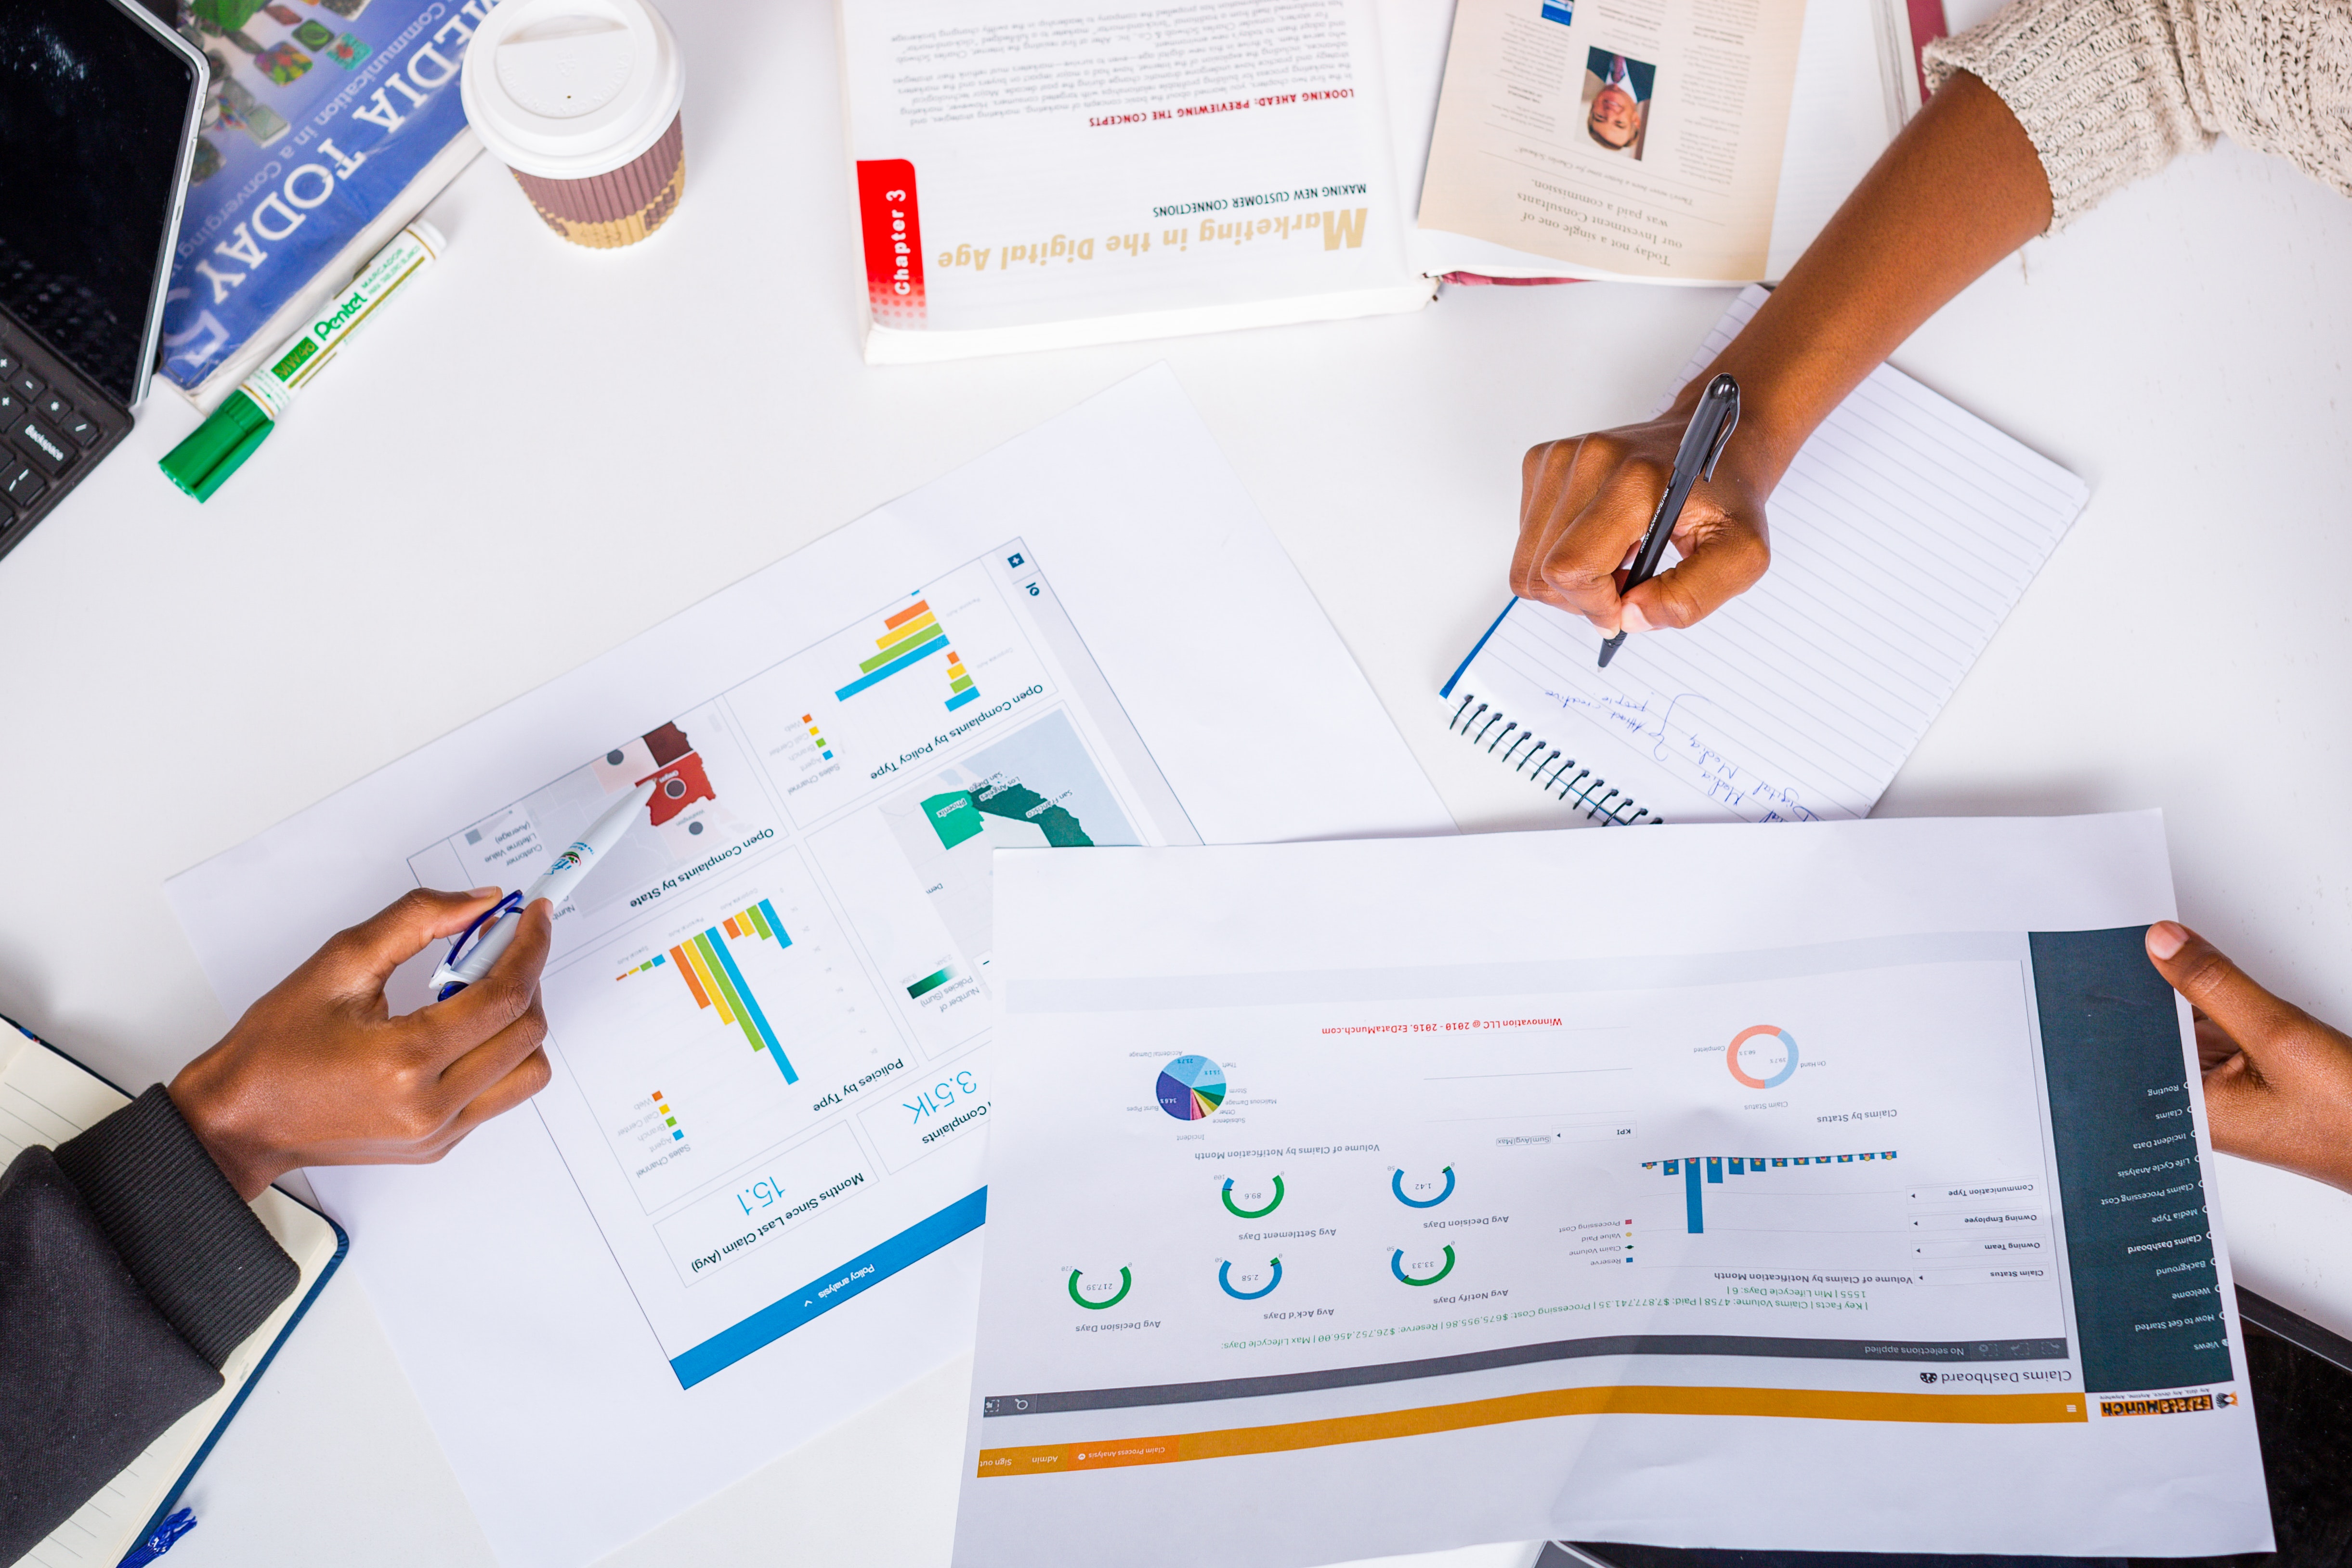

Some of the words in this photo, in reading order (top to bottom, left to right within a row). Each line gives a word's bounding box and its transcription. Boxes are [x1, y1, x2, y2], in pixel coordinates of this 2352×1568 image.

[312, 0, 448, 130] Communication
[1255, 93, 1297, 107] AHEAD:
[1301, 88, 1354, 102] LOOKING
[1151, 109, 1172, 120] THE
[1176, 99, 1250, 118] PREVIEWING
[1088, 112, 1147, 127] CONCEPTS
[290, 124, 318, 151] in
[277, 144, 296, 163] a
[885, 189, 906, 201] 3
[1293, 187, 1318, 201] NEW
[1321, 183, 1366, 197] MAKING
[1530, 178, 1604, 208] commission.
[1231, 191, 1290, 208] CUSTOMER
[174, 156, 283, 261] Converging
[1152, 198, 1228, 218] CONNECTIONS
[1516, 192, 1588, 223] Consultants
[1606, 202, 1614, 211] a
[1615, 205, 1643, 220] paid
[186, 128, 368, 305] TODAY
[1519, 211, 1535, 222] of
[1537, 216, 1560, 229] one
[1646, 215, 1669, 228] was
[1198, 207, 1368, 251] Marketing
[1562, 223, 1596, 242] single
[1591, 215, 1658, 245] Investment
[1105, 231, 1151, 257] the
[1162, 227, 1188, 252] in
[1600, 235, 1607, 244] a
[1610, 238, 1630, 251] not
[1661, 236, 1683, 249] our
[890, 209, 911, 294] Chapter
[937, 242, 991, 272] Age
[1000, 233, 1095, 271] Digital
[1633, 244, 1671, 267] Today
[360, 246, 405, 290] MARCADOR
[311, 286, 368, 342] Pentel
[1011, 684, 1043, 704] Open
[948, 701, 1012, 737] Complaints
[934, 734, 949, 746] by
[899, 742, 934, 765] Policy
[870, 762, 899, 780] Type
[988, 770, 1003, 783] San
[967, 776, 990, 794] Diego
[1006, 775, 1020, 787] Los
[978, 780, 1007, 802] Angeles
[1058, 788, 1073, 801] San
[1701, 772, 1746, 806] Media
[936, 797, 967, 819] Phoenix
[742, 828, 774, 848] Open
[677, 845, 742, 882] Complaints
[662, 878, 678, 891] by
[629, 887, 661, 907] State
[1445, 1021, 1470, 1031] 2010
[1482, 1020, 1501, 1029] LLC
[1502, 1017, 1563, 1028] Winnovation
[1321, 1024, 1408, 1035] EzDataMunch.com
[858, 1058, 904, 1086] Policies
[843, 1083, 859, 1096] by
[2146, 1084, 2180, 1097] Routing
[812, 1093, 843, 1111] Type
[902, 1070, 977, 1125] 3.51K
[1816, 1113, 1849, 1123] Status
[1850, 1111, 1863, 1121] by
[1863, 1108, 1897, 1119] Claims
[2155, 1108, 2183, 1120] Claims
[921, 1105, 987, 1144] Complaints
[2132, 1140, 2153, 1150] Data
[2152, 1132, 2187, 1146] Incident
[2151, 1160, 2174, 1172] Cycle
[2174, 1157, 2191, 1167] Life
[2117, 1165, 2152, 1178] Analysis
[818, 1172, 864, 1201] Months
[1947, 1188, 1968, 1197] Type
[1968, 1183, 2034, 1196] Communication
[2165, 1182, 2195, 1194] Claims
[736, 1176, 786, 1216] 15.1
[2100, 1196, 2120, 1205] Cost
[2119, 1189, 2166, 1202] Processing
[784, 1198, 819, 1220] Since
[2172, 1207, 2198, 1219] Media
[1423, 1220, 1446, 1229] Days
[1447, 1217, 1490, 1227] Decision
[1491, 1215, 1509, 1223] Avg
[1963, 1215, 2003, 1224] Employee
[2004, 1214, 2038, 1222] Owning
[2151, 1213, 2173, 1223] Type
[756, 1215, 785, 1237] Last
[721, 1232, 757, 1254] Claim
[2173, 1233, 2202, 1245] Claims
[2127, 1240, 2173, 1254] Dashboard
[691, 1249, 722, 1273] (Avg)
[1411, 1260, 1434, 1269] 33.33
[849, 1263, 875, 1281] Policy
[2155, 1260, 2207, 1277] Background
[1713, 1272, 1747, 1281] Month
[1748, 1273, 1810, 1283] Notification
[1811, 1274, 1824, 1283] by
[1824, 1275, 1860, 1284] Claims
[1861, 1276, 1873, 1284] of
[1874, 1276, 1914, 1284] Volume
[817, 1276, 850, 1299] analysis
[1085, 1282, 1113, 1291] 217.39
[1490, 1289, 1509, 1297] Avg
[1731, 1286, 1739, 1295] 6
[1769, 1287, 1812, 1297] Lifecycle
[2171, 1286, 2211, 1300] Welcome
[1432, 1295, 1456, 1304] Days
[1457, 1292, 1489, 1302] Notify
[1814, 1290, 1833, 1298] Min
[1840, 1290, 1866, 1299] 1555
[1672, 1297, 1697, 1306] Paid:
[1703, 1297, 1731, 1307] 4758
[1733, 1298, 1773, 1308] Volume:
[1774, 1299, 1808, 1309] Claims
[1815, 1301, 1842, 1310] Facts
[1843, 1300, 1863, 1310] Key
[1510, 1309, 1536, 1319] Cost:
[1537, 1302, 1591, 1315] Processing
[1142, 1319, 1162, 1329] Avg
[2167, 1319, 2183, 1328] Get
[2194, 1313, 2215, 1323] How
[1075, 1323, 1098, 1333] Days
[1099, 1321, 1141, 1332] Decision
[1398, 1322, 1438, 1333] Reserve:
[2134, 1321, 2167, 1333] Started
[1248, 1337, 1289, 1348] Lifecycle
[1291, 1336, 1311, 1345] Max
[2193, 1340, 2220, 1350] Views
[1941, 1372, 2019, 1385] Dashboard
[2022, 1370, 2072, 1382] Claims
[1087, 1450, 1117, 1459] Analysis
[1117, 1448, 1144, 1456] Process
[1145, 1446, 1165, 1454] Claim
[994, 1457, 1013, 1466] Sign
[1031, 1454, 1058, 1464] Admin
